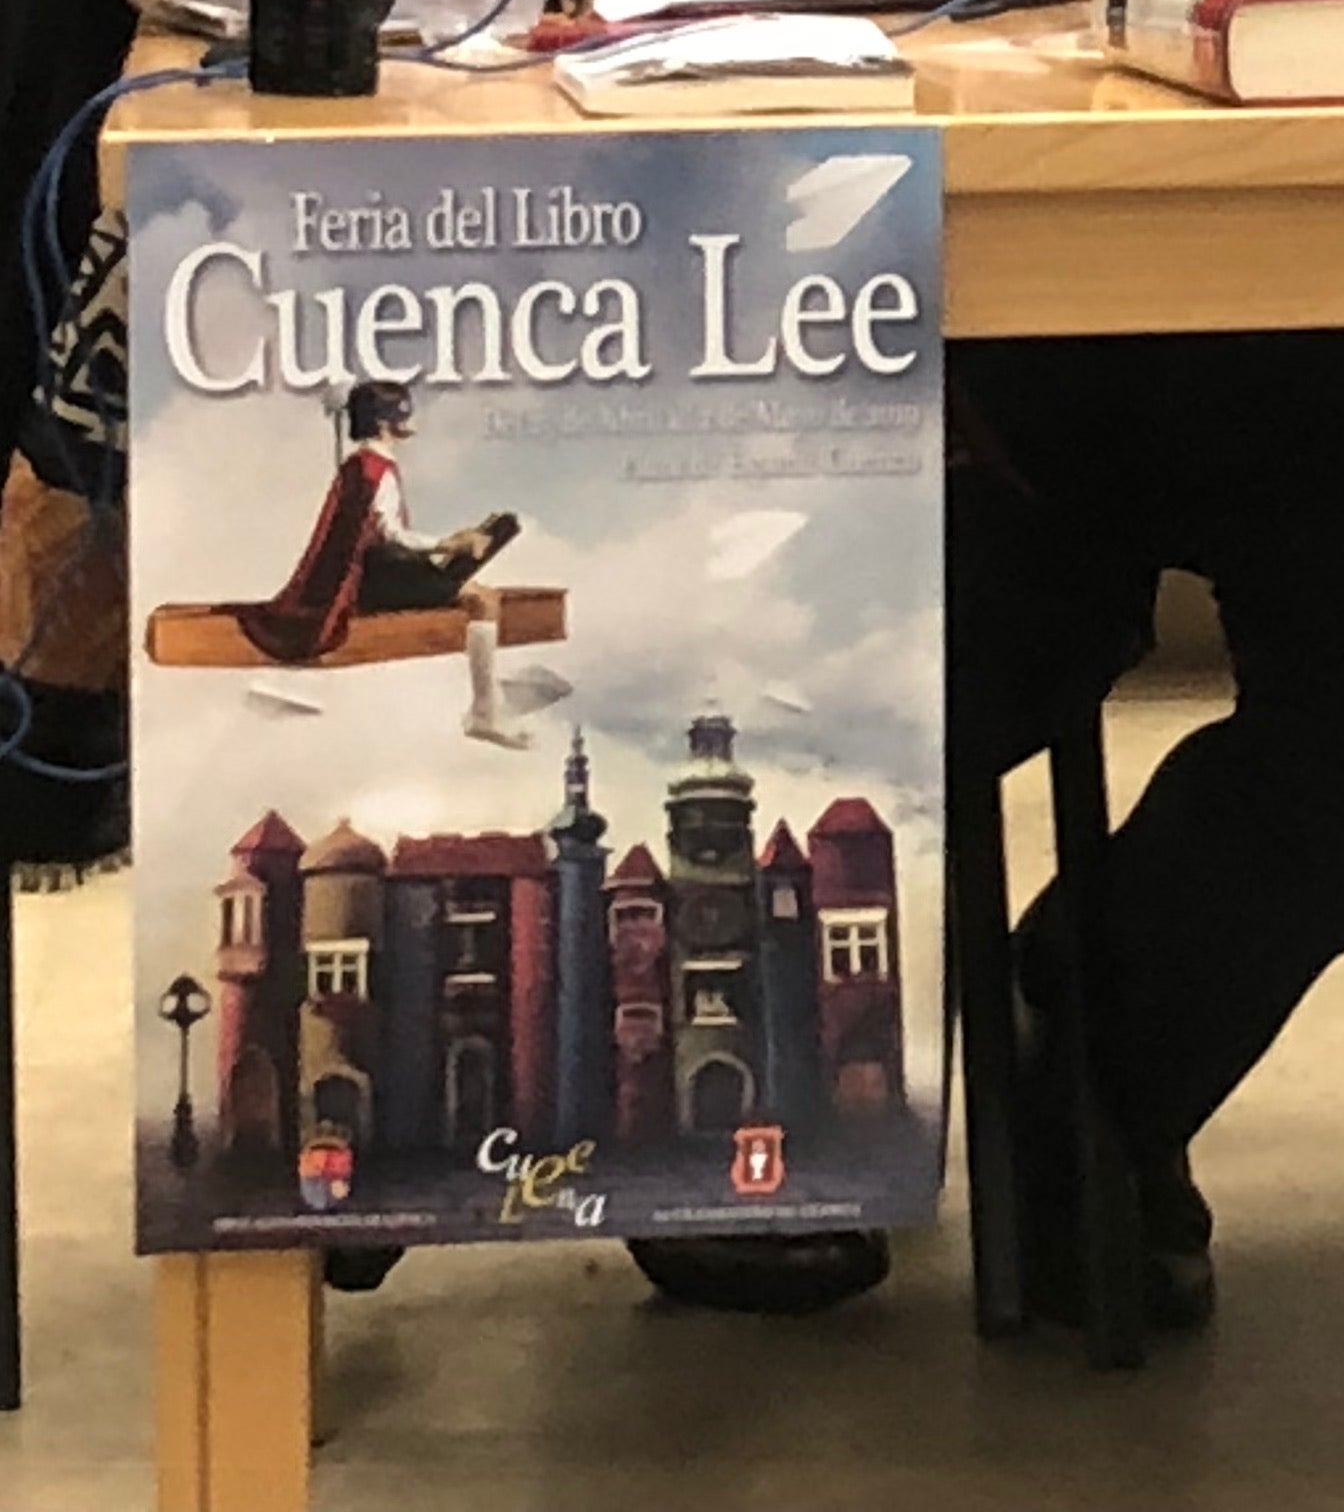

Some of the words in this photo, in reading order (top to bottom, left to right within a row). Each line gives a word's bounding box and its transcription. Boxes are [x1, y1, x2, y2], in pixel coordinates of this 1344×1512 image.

[291, 190, 413, 252] Feria
[426, 186, 498, 249] del
[516, 185, 643, 248] Libro
[162, 240, 653, 394] Cuenca
[689, 231, 921, 381] Lee
